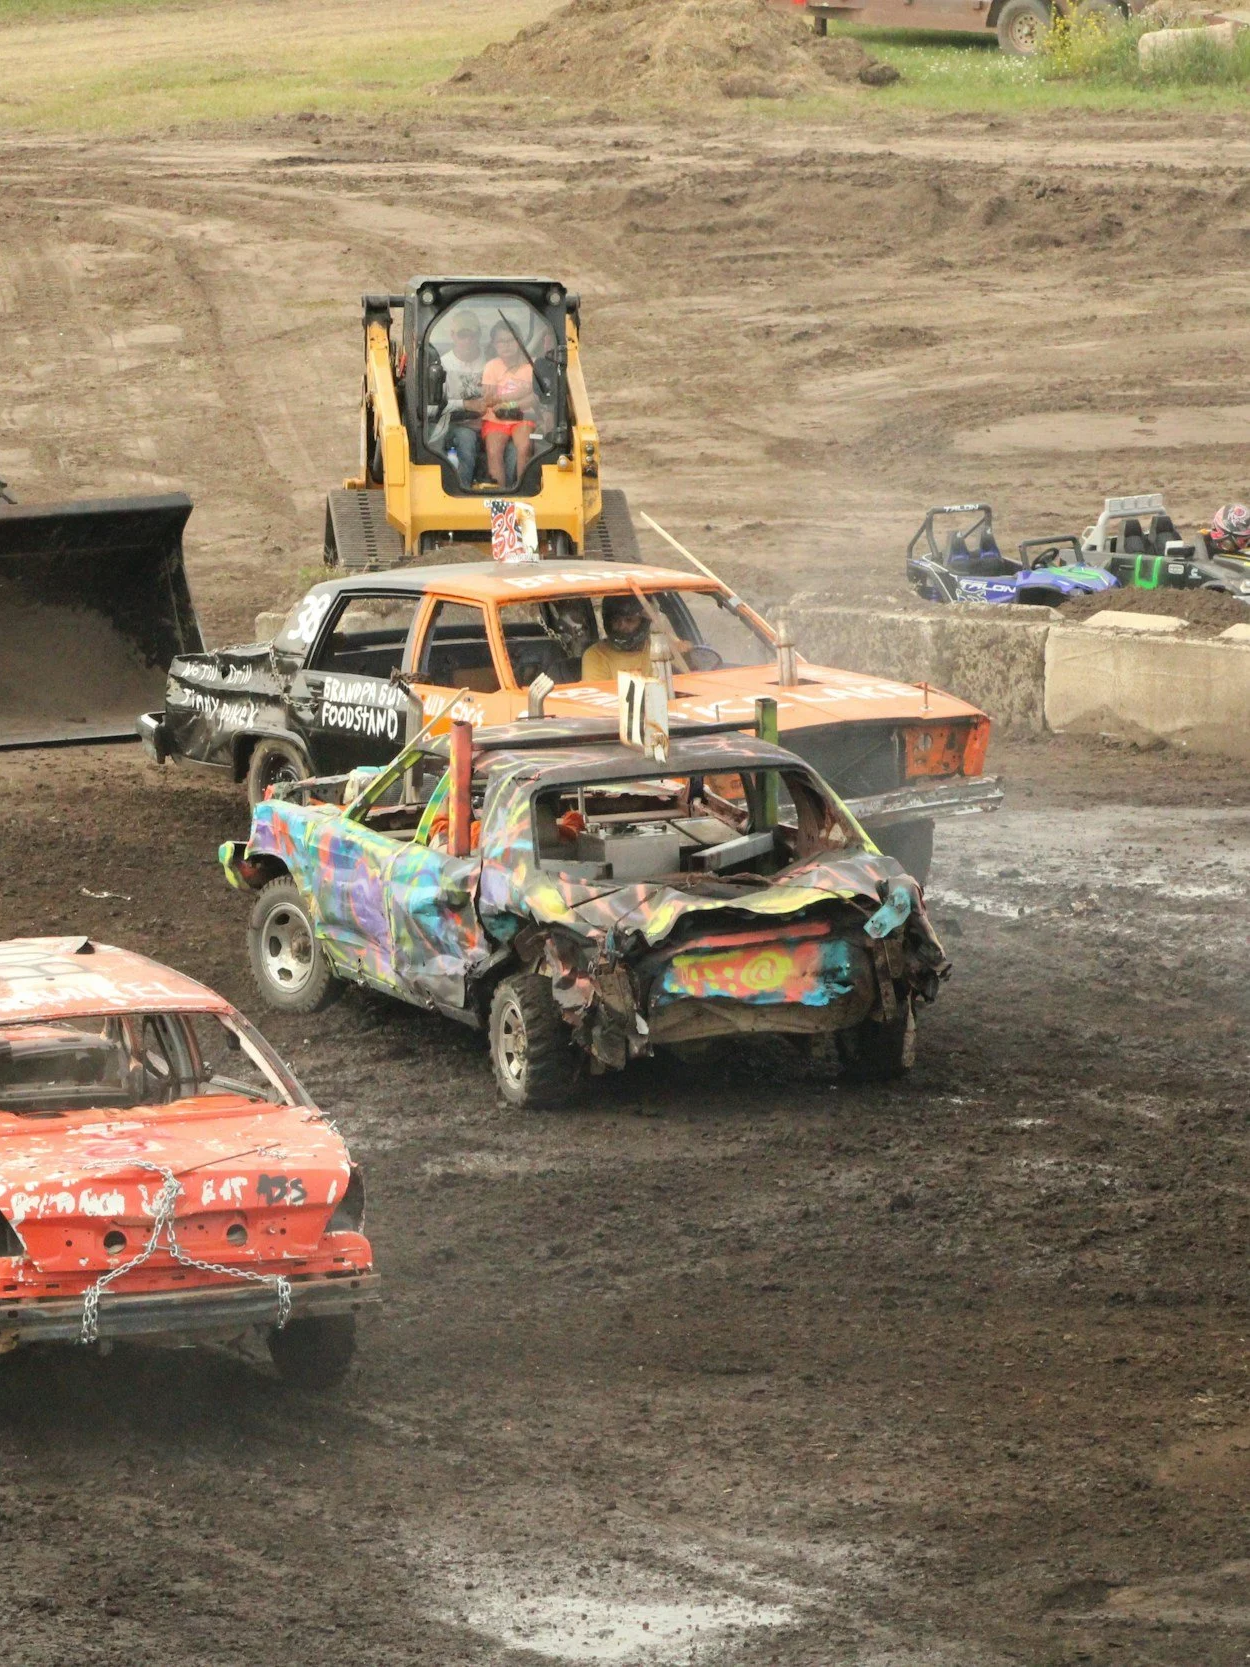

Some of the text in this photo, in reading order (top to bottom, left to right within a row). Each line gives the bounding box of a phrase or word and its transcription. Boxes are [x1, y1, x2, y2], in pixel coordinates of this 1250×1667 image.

[944, 504, 979, 512] TALON
[492, 504, 516, 560] 38
[960, 580, 1016, 593] TALON
[287, 593, 331, 643] 38
[181, 662, 252, 684] No Till Drill
[323, 676, 376, 704] GRANDPA
[781, 684, 923, 702] LAKE
